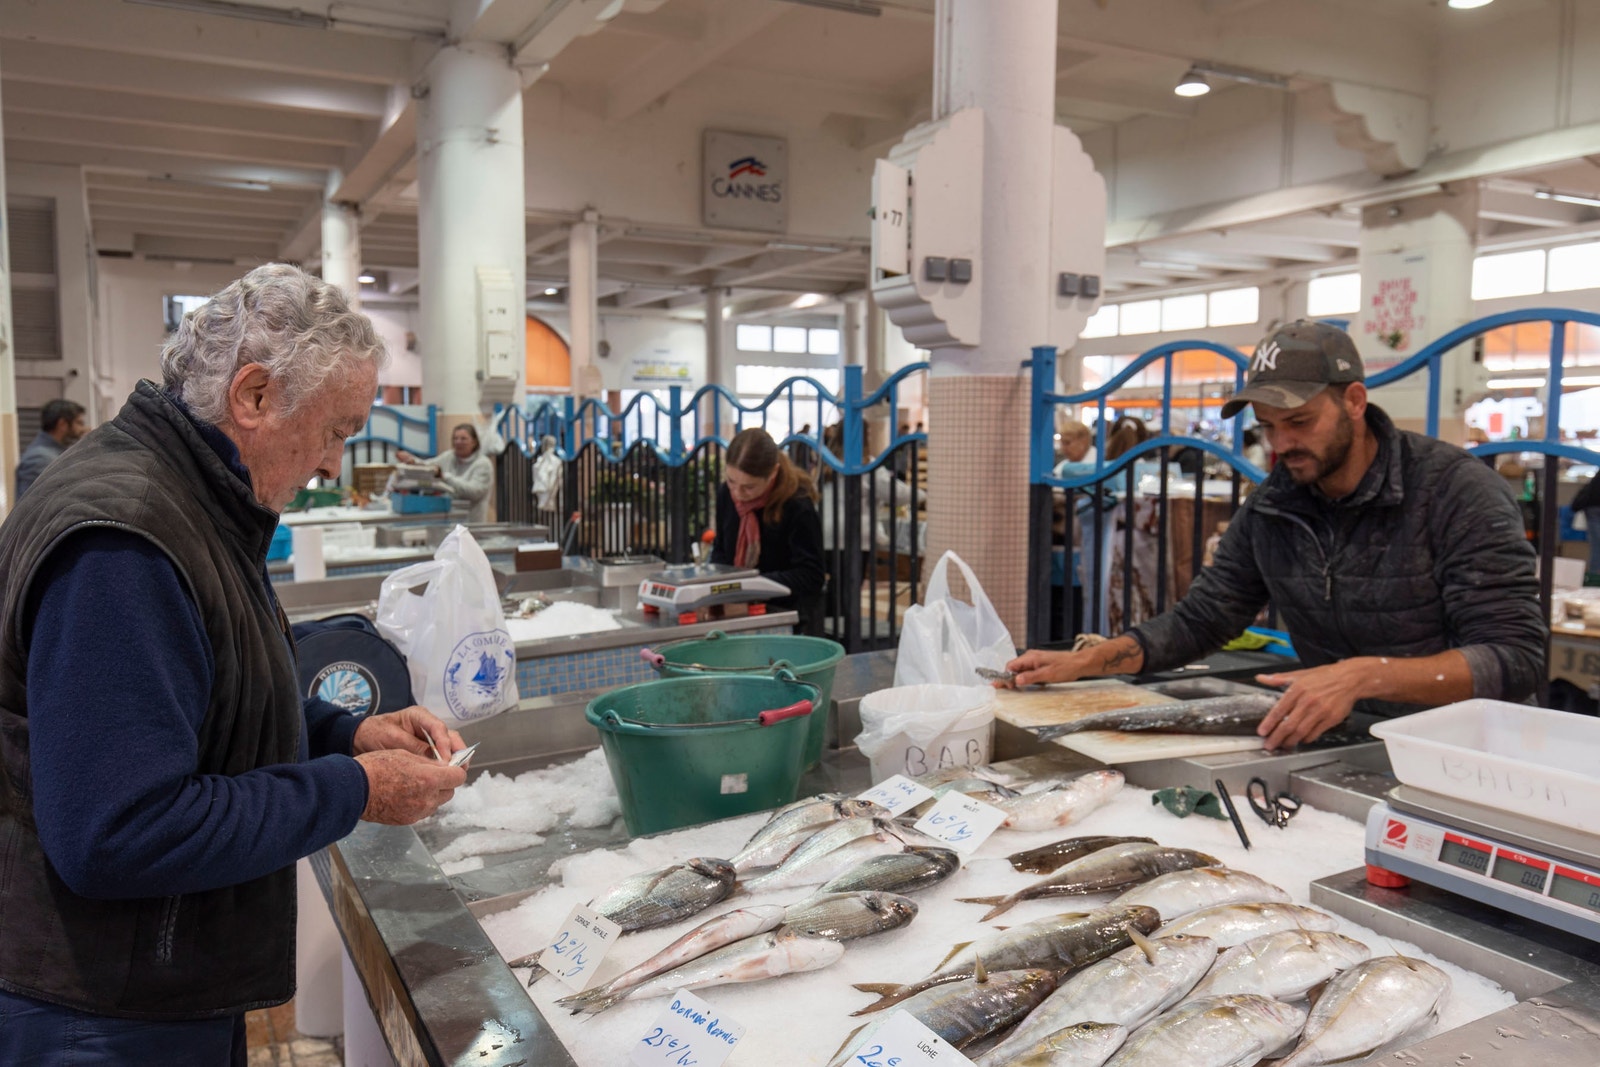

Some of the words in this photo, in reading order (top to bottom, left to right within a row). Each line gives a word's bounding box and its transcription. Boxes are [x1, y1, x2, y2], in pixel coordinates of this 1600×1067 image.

[711, 177, 782, 203] CANNES
[891, 210, 903, 227] 77
[1252, 341, 1281, 372] NY
[905, 739, 982, 777] BAB
[916, 1041, 939, 1060] LICHE
